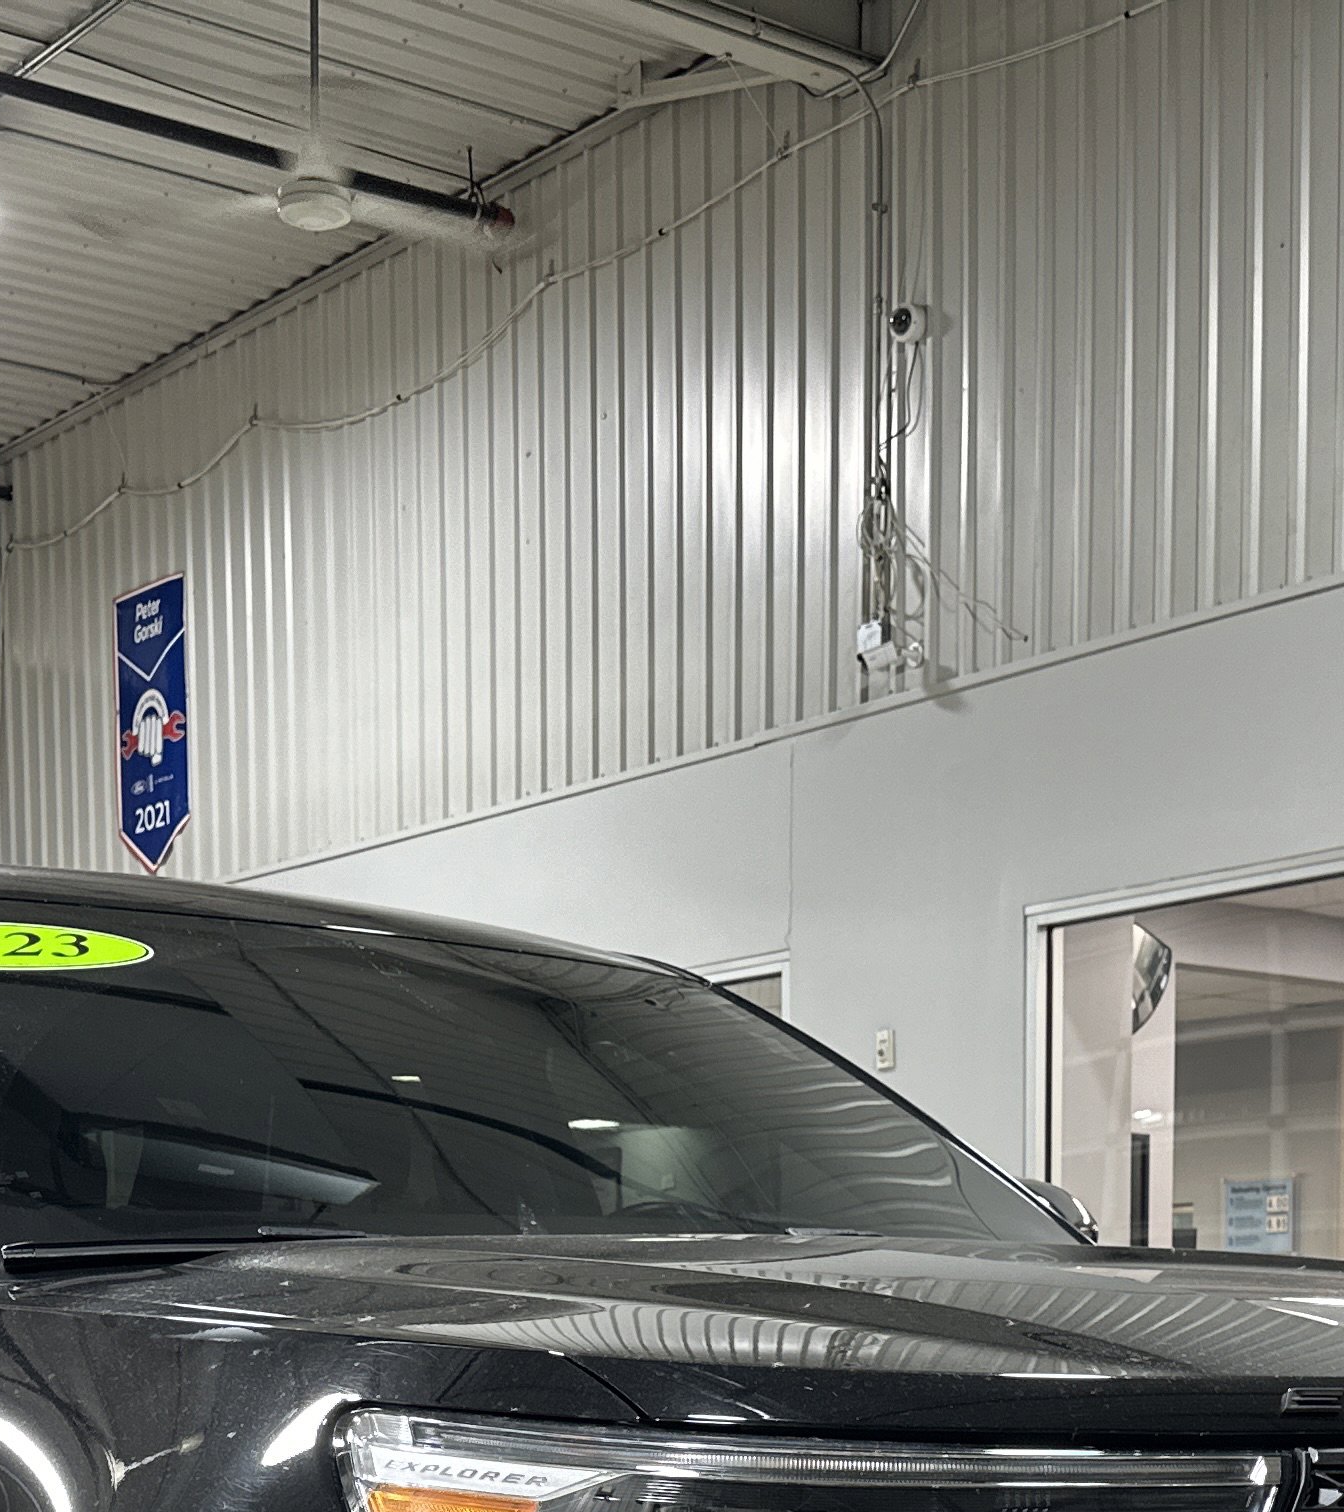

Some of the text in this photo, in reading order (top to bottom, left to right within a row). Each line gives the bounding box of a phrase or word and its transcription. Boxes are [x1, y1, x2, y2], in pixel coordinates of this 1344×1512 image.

[135, 599, 161, 622] Peter
[134, 615, 164, 643] Gorski
[135, 800, 170, 834] 2021
[384, 1459, 549, 1487] EXPLORER
